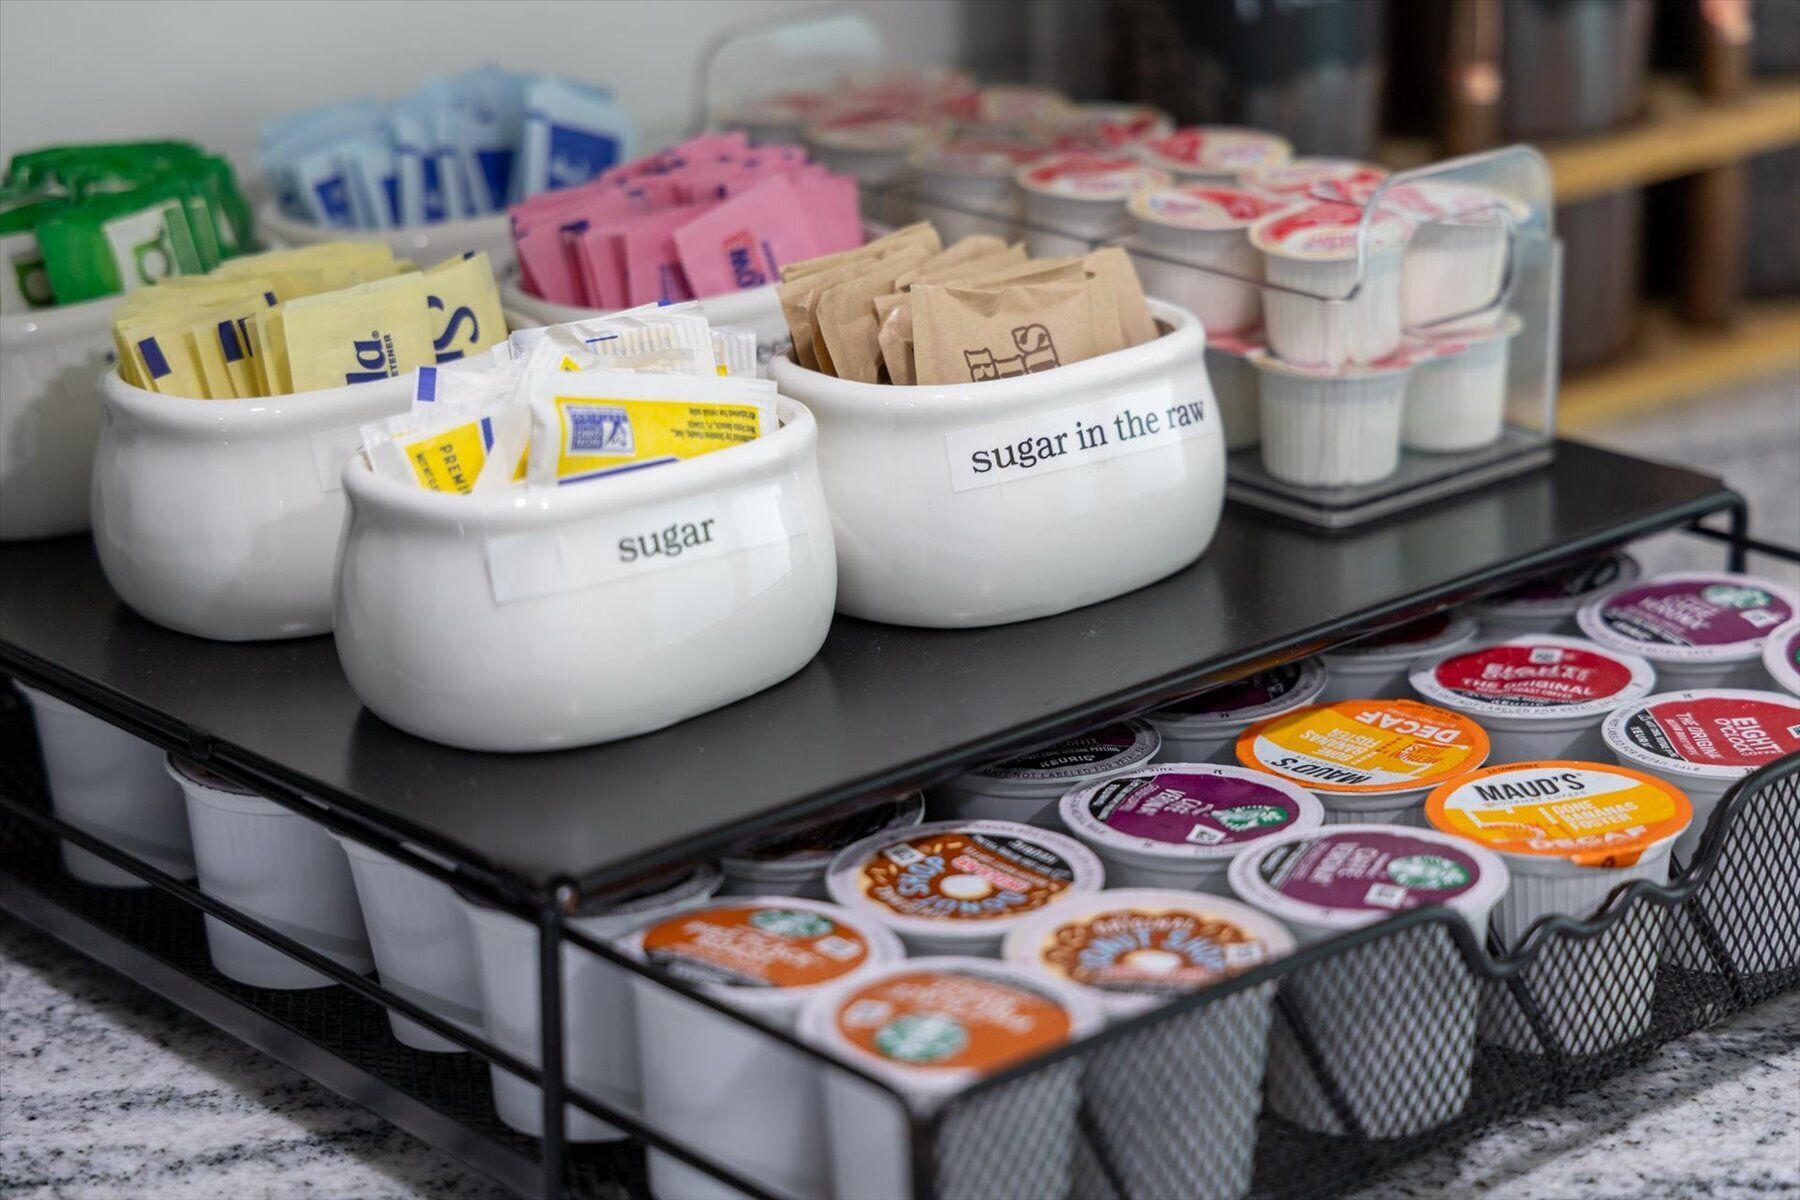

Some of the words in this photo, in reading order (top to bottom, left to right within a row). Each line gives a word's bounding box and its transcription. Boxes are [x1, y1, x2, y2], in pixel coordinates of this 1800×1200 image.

[971, 431, 1068, 473] sugar
[1076, 422, 1108, 450] in
[1114, 410, 1161, 441] the
[1167, 400, 1205, 430] raw
[618, 518, 715, 562] sugar
[1504, 680, 1595, 696] ORIGINAL
[1355, 710, 1461, 744] DECAF
[1730, 717, 1783, 753] EIGHT
[1040, 755, 1095, 768] KEURIG
[1271, 758, 1372, 785] MAUD'S
[1473, 773, 1585, 802] MAUD'S
